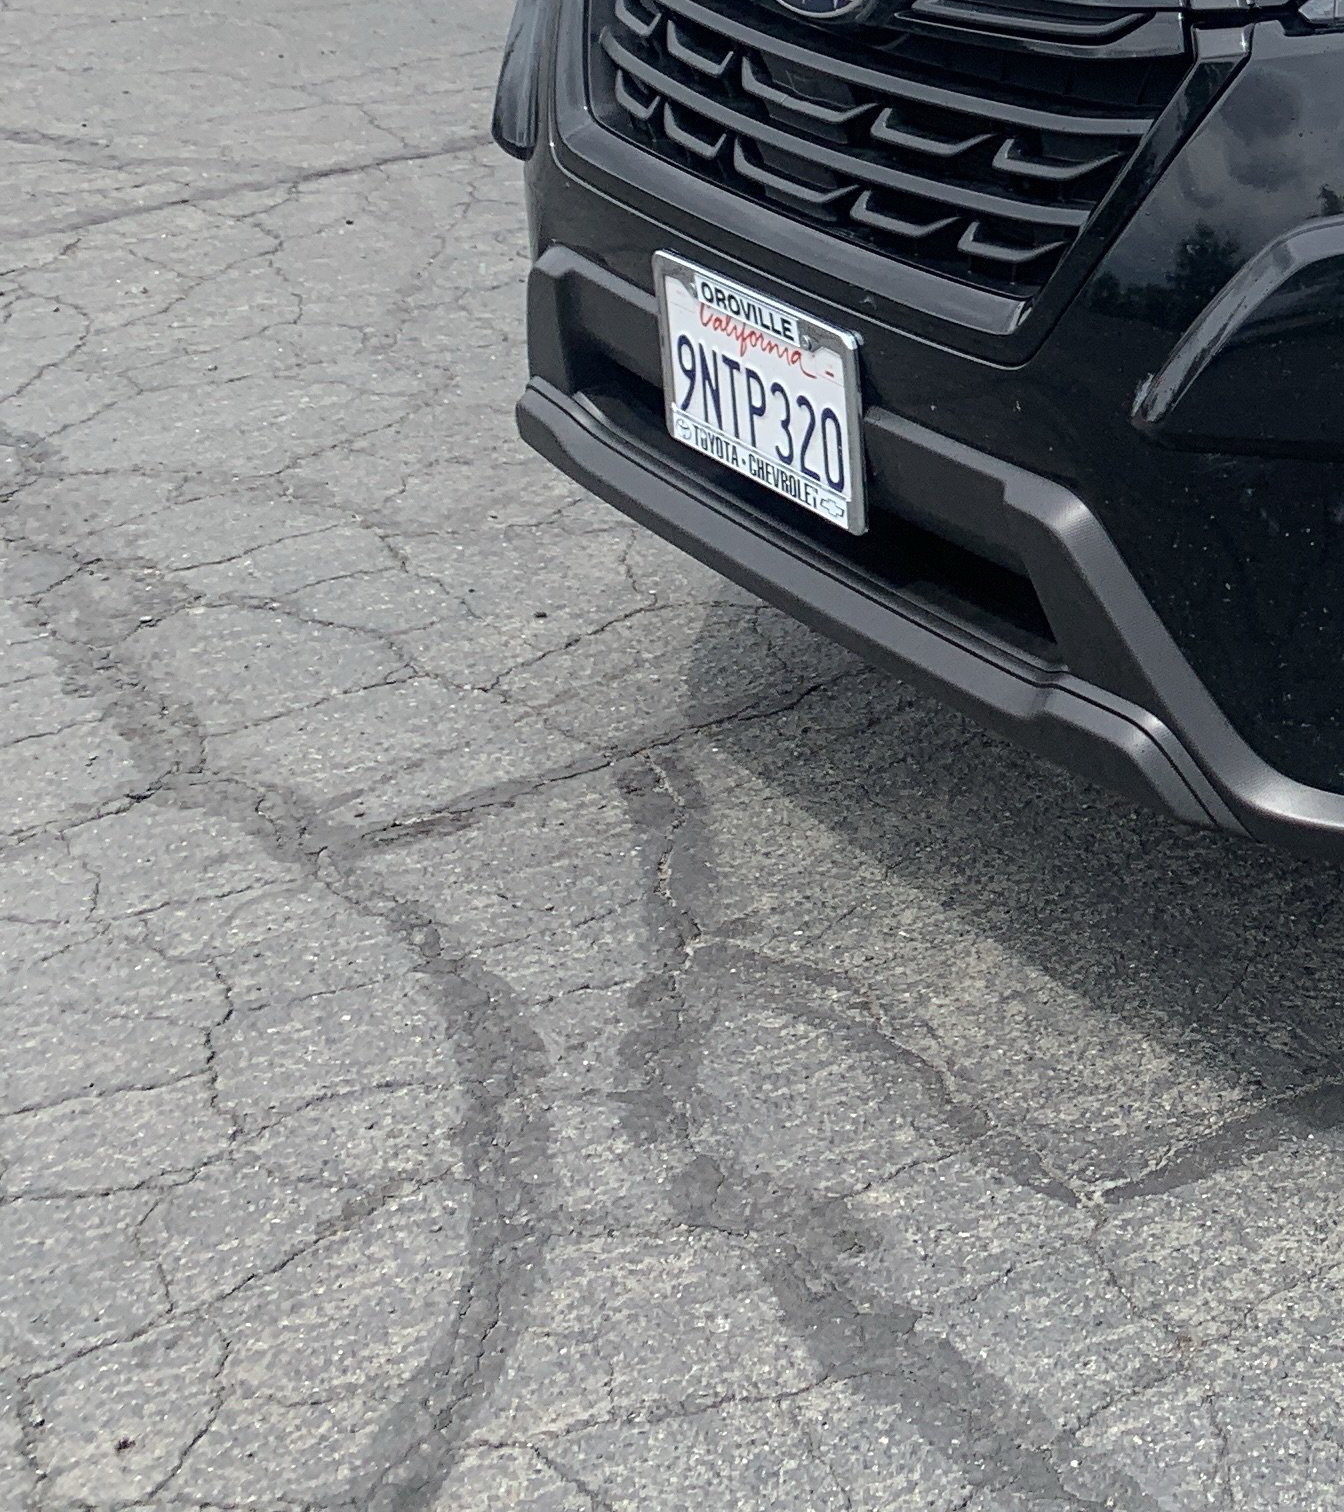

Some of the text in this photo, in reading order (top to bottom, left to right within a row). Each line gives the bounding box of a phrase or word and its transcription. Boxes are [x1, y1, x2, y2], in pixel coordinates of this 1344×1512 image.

[699, 303, 818, 380] California
[701, 282, 795, 342] OROVILLE
[676, 333, 846, 493] 9NTP320
[692, 423, 819, 509] TOYOTA CHEVROLET
